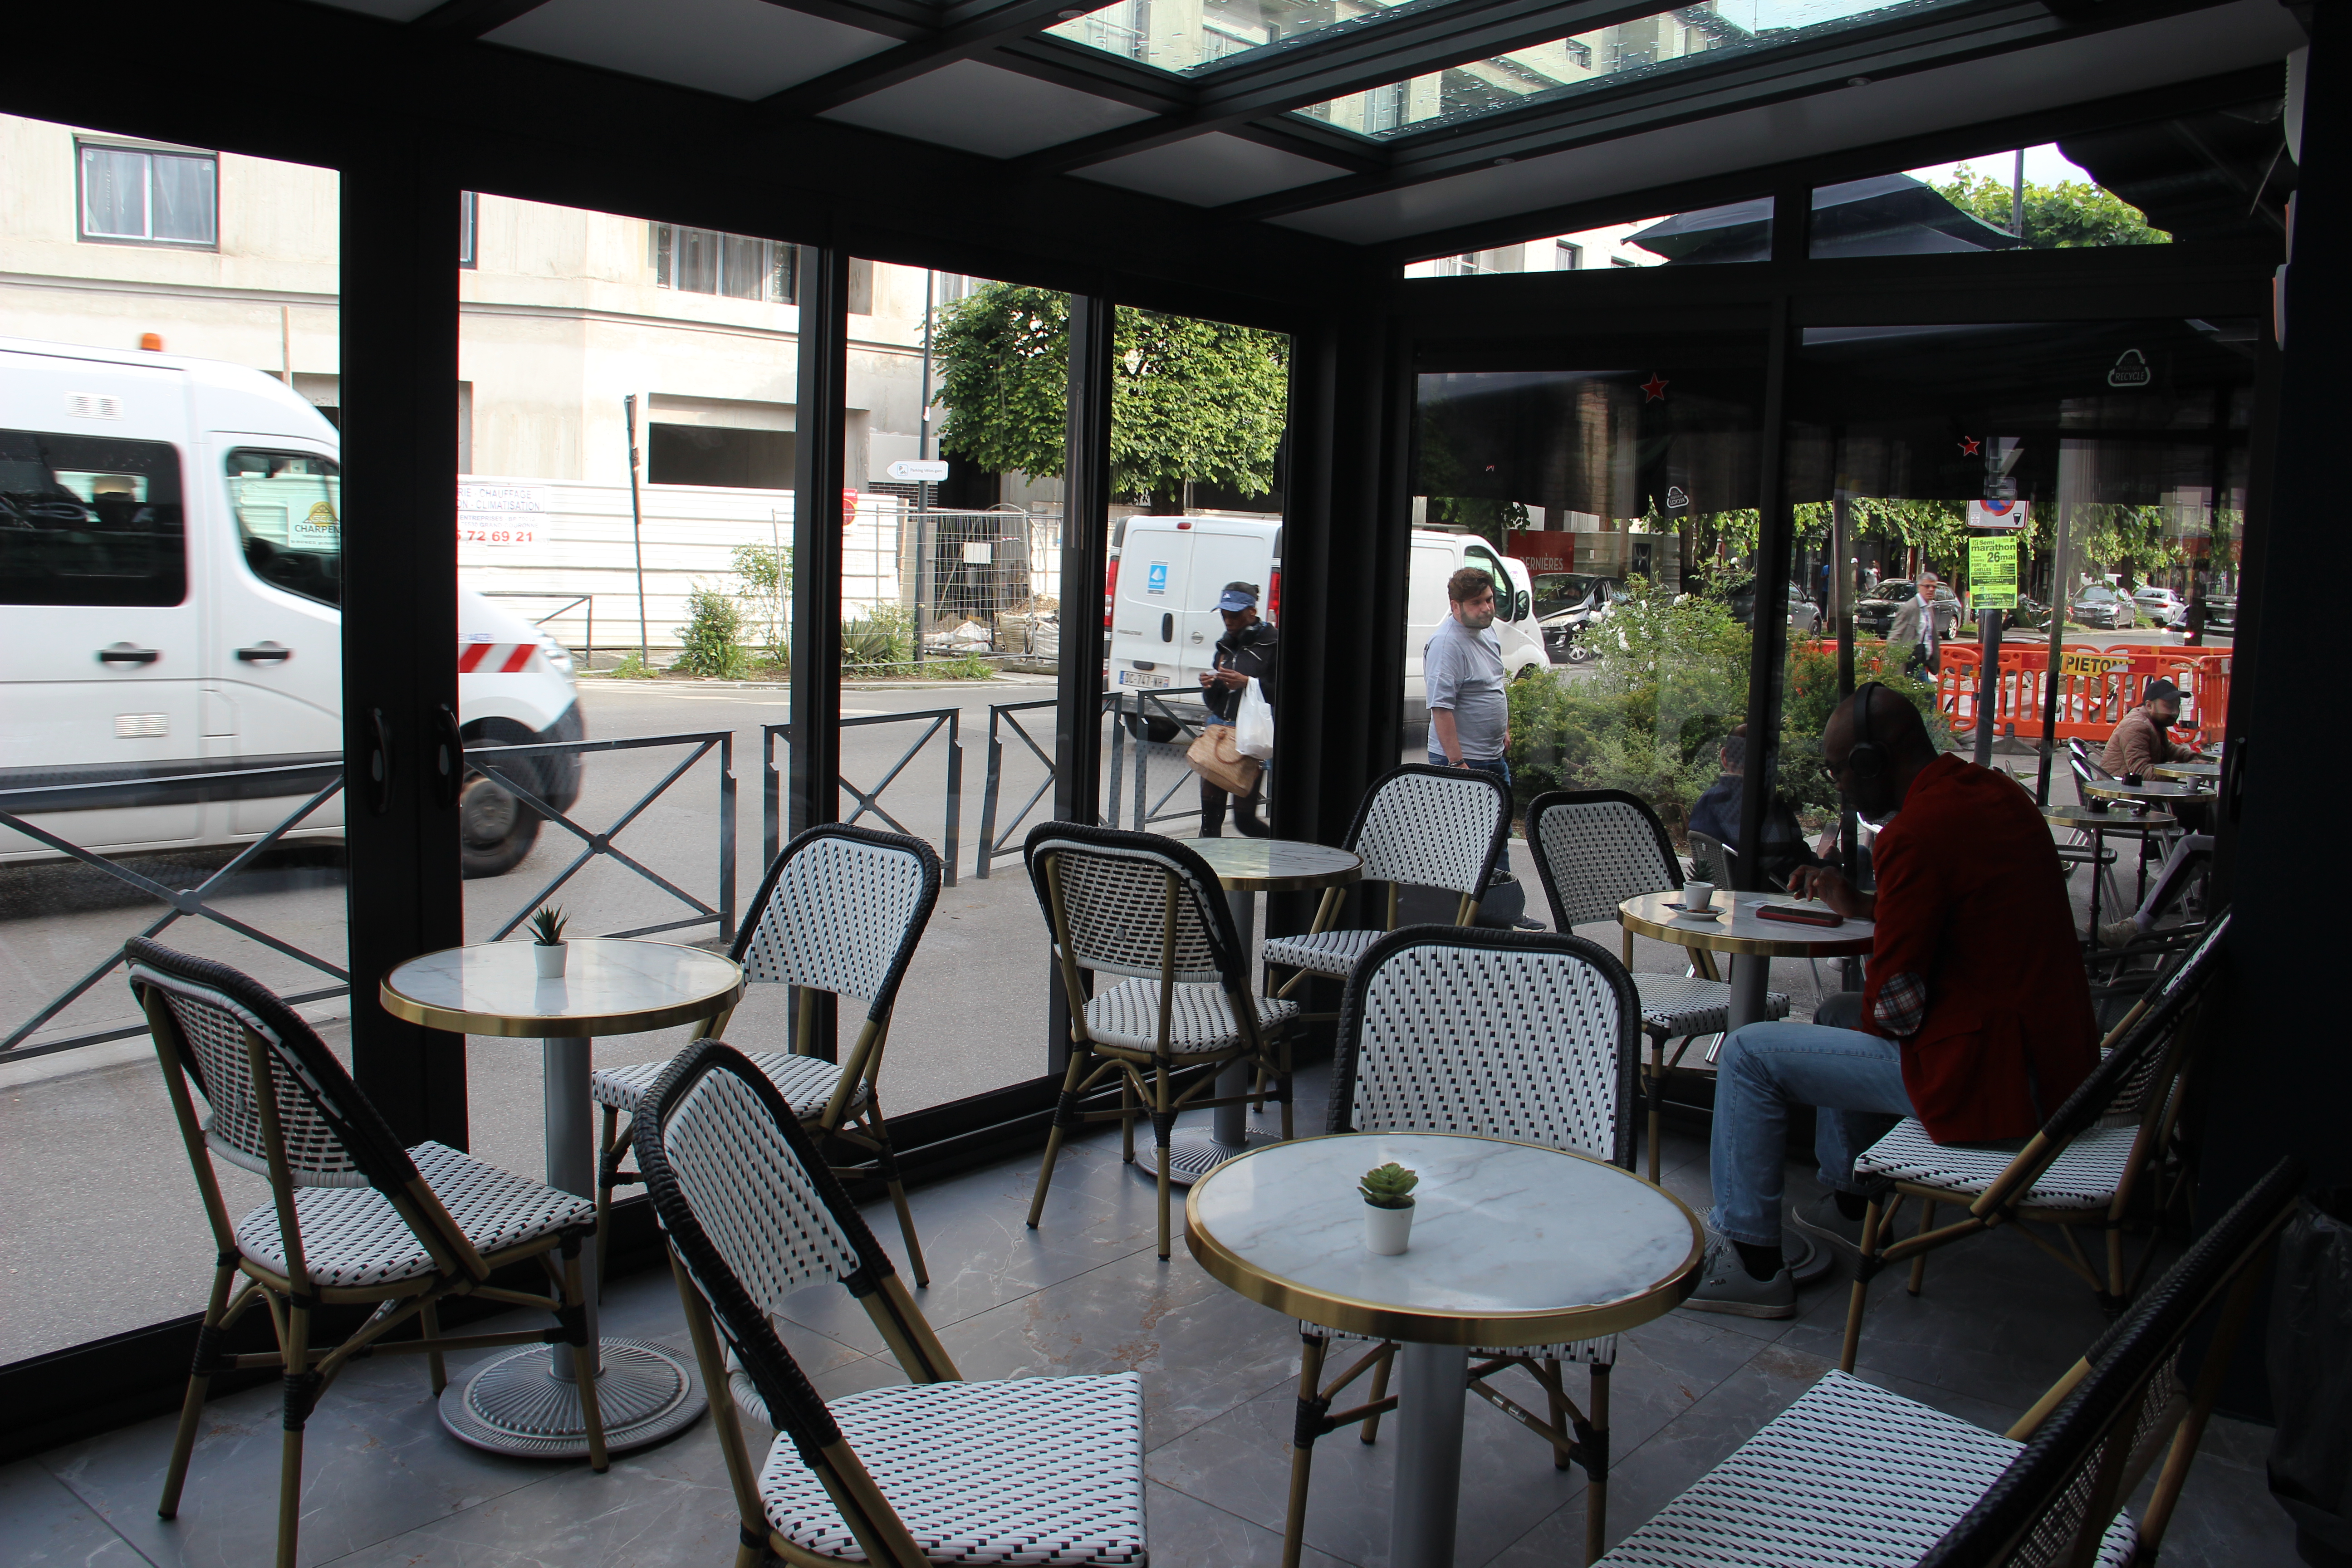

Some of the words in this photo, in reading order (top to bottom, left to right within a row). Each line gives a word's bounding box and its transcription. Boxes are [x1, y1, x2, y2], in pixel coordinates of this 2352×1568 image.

[480, 489, 532, 499] CHAUFFAGE
[476, 500, 540, 511] CLIMATISATION
[467, 530, 486, 541] 72
[492, 531, 510, 541] 69
[515, 531, 532, 542] 21
[1971, 544, 2016, 552] marathon
[1987, 552, 2000, 563] 26
[1710, 1278, 1727, 1287] FILA
